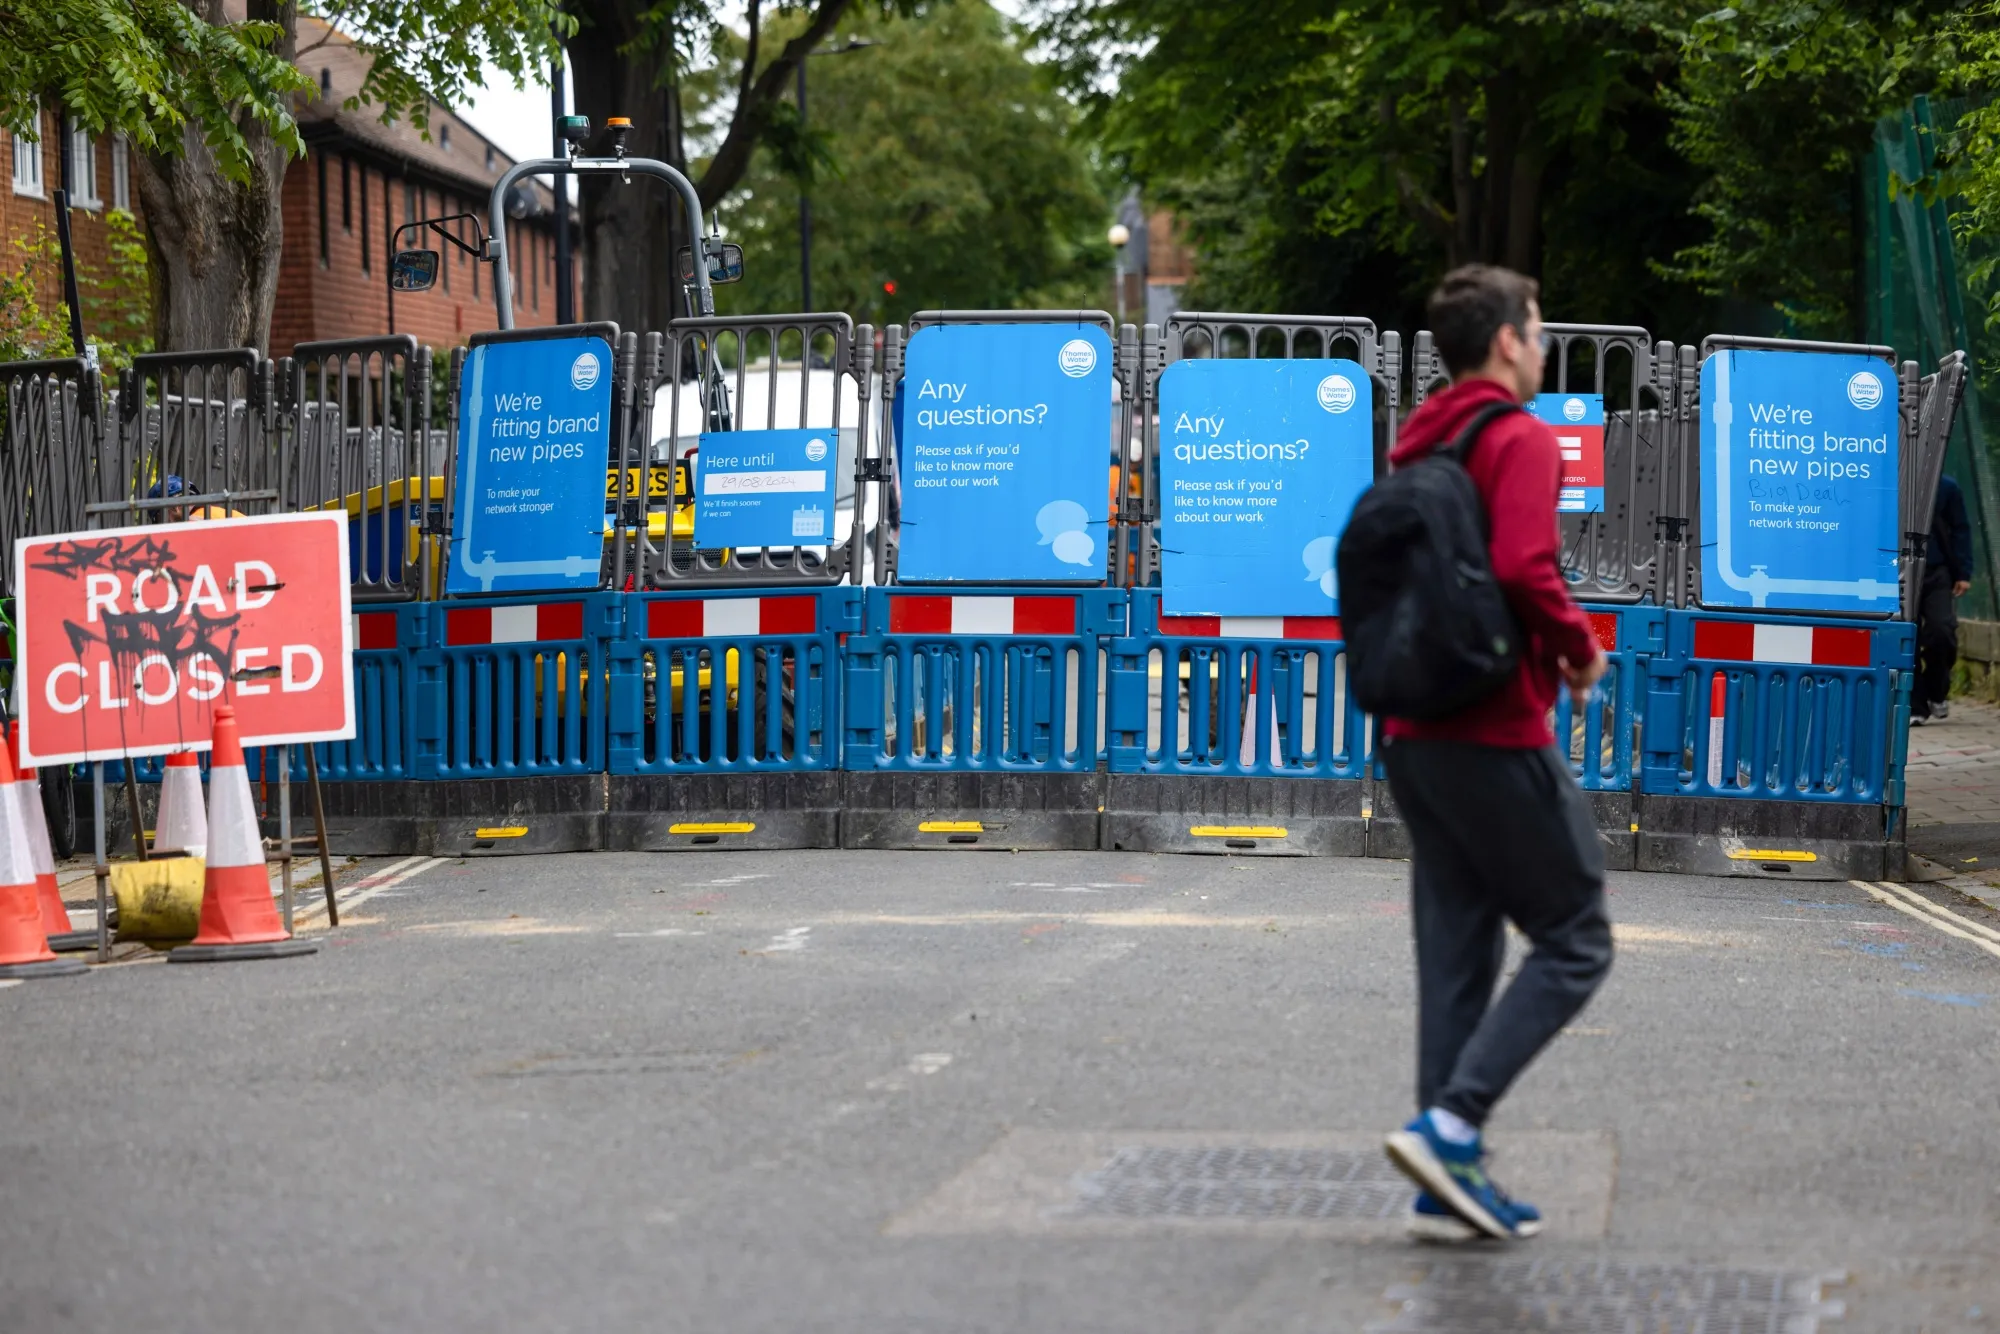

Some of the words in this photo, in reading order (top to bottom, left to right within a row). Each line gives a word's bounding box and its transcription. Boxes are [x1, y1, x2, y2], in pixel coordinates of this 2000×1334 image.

[918, 378, 967, 403] Any
[1853, 383, 1878, 391] Thames
[494, 392, 542, 413] We're
[917, 403, 1048, 430] questions?
[1749, 403, 1813, 425] We're
[492, 416, 541, 439] fitting
[547, 412, 600, 434] brand
[1174, 413, 1225, 438] Any
[1749, 428, 1815, 455] fitting
[1824, 431, 1887, 454] brand
[489, 446, 527, 462] new
[532, 440, 584, 464] pipes
[915, 445, 951, 456] Please
[953, 444, 973, 455] ask
[975, 444, 984, 455] if
[986, 444, 1020, 458] you'd
[1174, 439, 1309, 465] questions?
[706, 455, 739, 468] Here
[743, 452, 775, 467] until
[914, 461, 934, 472] like
[936, 462, 948, 472] to
[951, 460, 981, 471] know
[984, 462, 1014, 471] more
[1749, 458, 1799, 475] new
[1807, 457, 1870, 481] pipes
[914, 477, 948, 488] about
[950, 478, 970, 487] our
[972, 476, 999, 487] work
[1174, 480, 1212, 491] Please
[1214, 480, 1234, 490] ask
[1237, 479, 1246, 490] if
[1249, 480, 1282, 493] you'd
[486, 488, 496, 499] To
[497, 487, 520, 498] make
[520, 488, 540, 500] your
[1174, 496, 1194, 507] like
[1197, 497, 1210, 506] to
[1212, 495, 1243, 506] know
[1247, 497, 1277, 506] more
[485, 502, 517, 514] network
[518, 502, 554, 514] stronger
[721, 499, 738, 507] finish
[1749, 501, 1762, 512] To
[1765, 502, 1795, 513] make
[1797, 505, 1821, 516] your
[1174, 512, 1210, 522] about
[1213, 513, 1232, 522] our
[1236, 511, 1263, 522] work
[1749, 518, 1793, 529] network
[1795, 519, 1840, 533] stronger
[86, 560, 278, 623] ROAD
[45, 644, 324, 714] CLOSED
